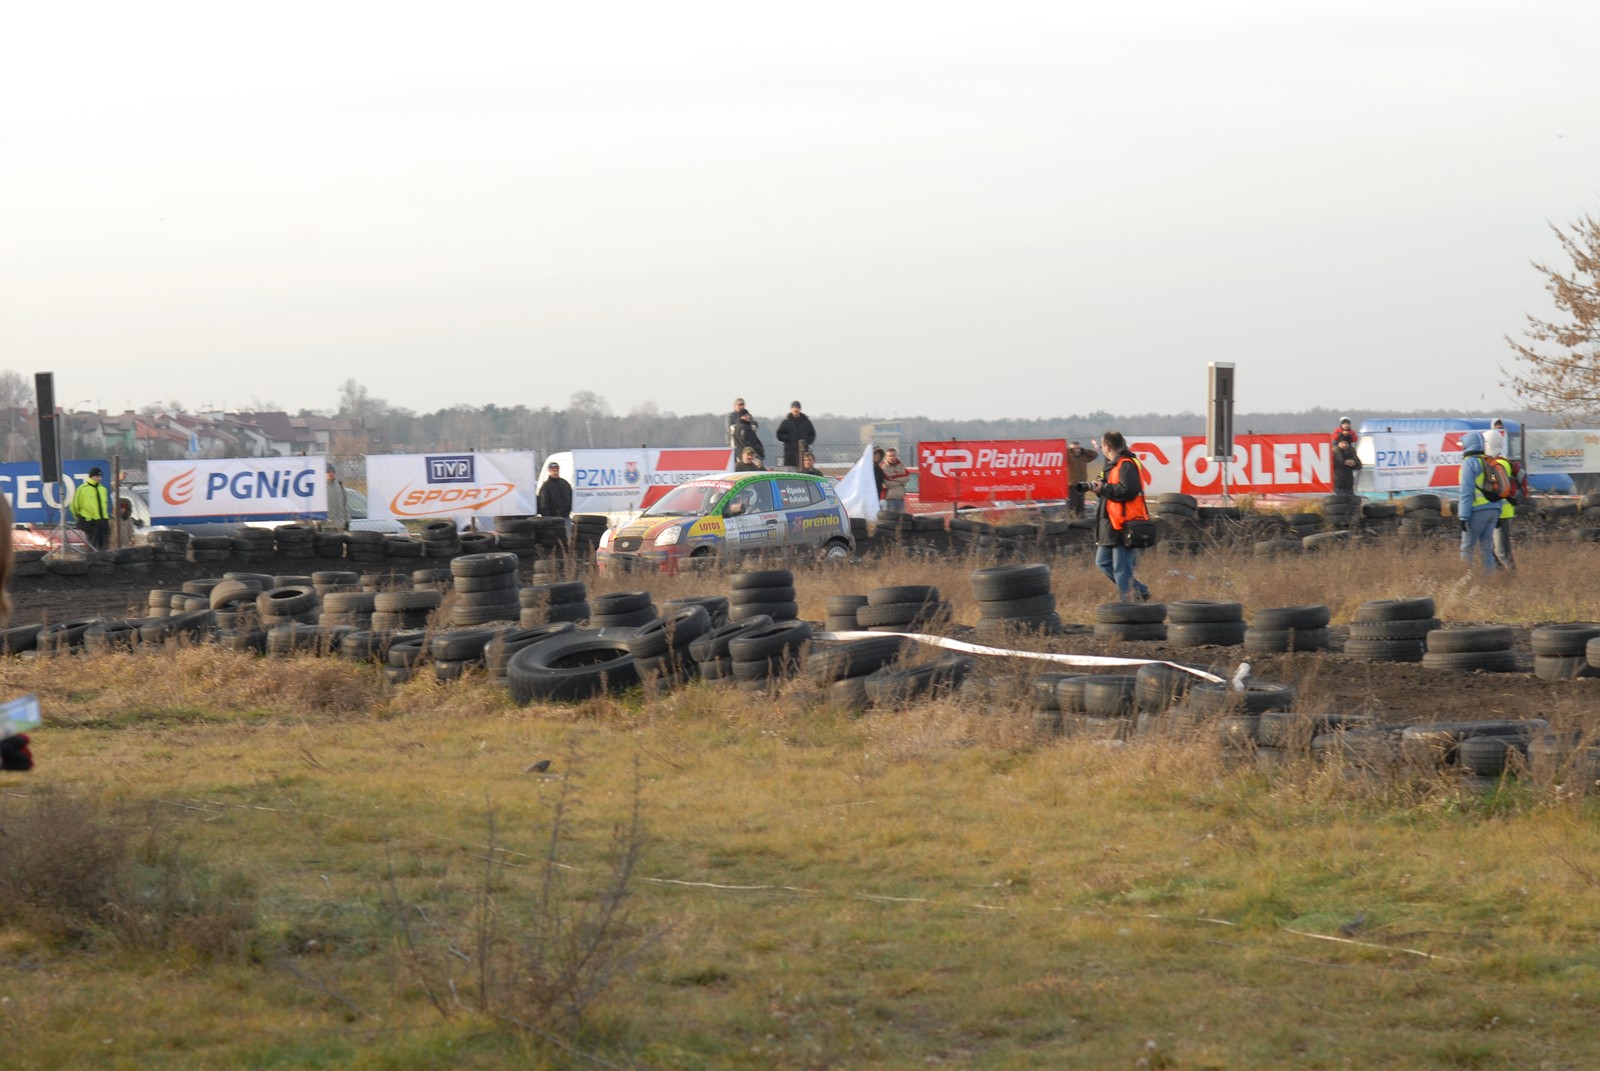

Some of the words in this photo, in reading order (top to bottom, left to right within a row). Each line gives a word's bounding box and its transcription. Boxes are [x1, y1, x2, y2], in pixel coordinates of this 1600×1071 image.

[976, 448, 1064, 468] Platinum
[1184, 442, 1332, 487] ORLEN
[1376, 450, 1411, 467] PZM
[434, 463, 467, 477] TVP
[576, 469, 617, 487] PZM
[1011, 468, 1062, 476] SPORT
[206, 469, 316, 501] PGNiG
[644, 474, 670, 485] MOC
[403, 488, 498, 506] SPORT
[699, 522, 720, 531] LOTOS
[803, 515, 839, 529] premio
